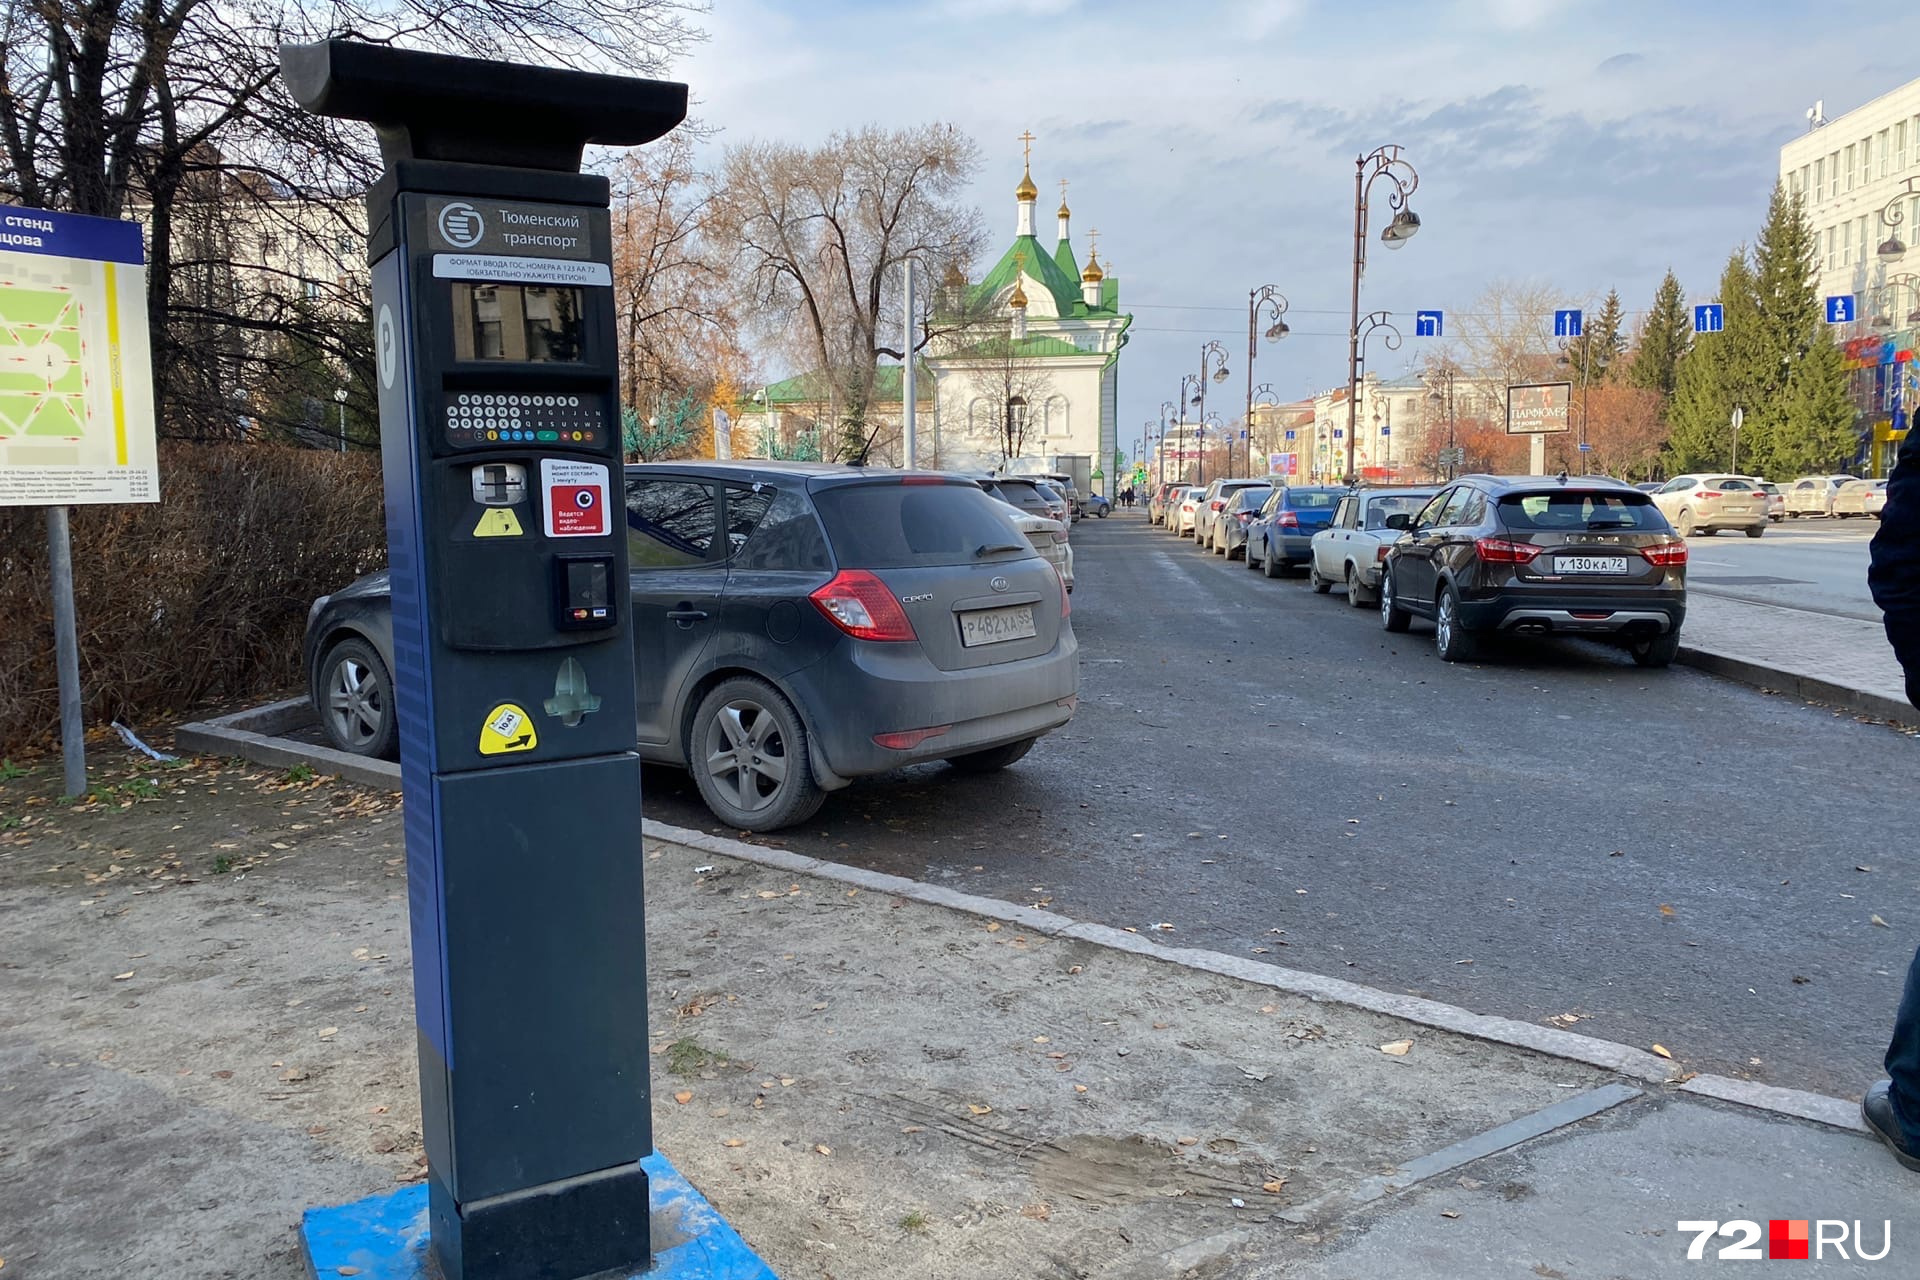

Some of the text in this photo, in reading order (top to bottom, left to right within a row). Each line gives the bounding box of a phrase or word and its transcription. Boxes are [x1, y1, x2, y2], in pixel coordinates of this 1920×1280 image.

[5, 215, 54, 233] стенд
[499, 209, 580, 229] Тюменский
[503, 233, 577, 250] транспорт
[449, 258, 482, 267] ФОРМАТ
[483, 260, 508, 269] ВВОДА
[509, 261, 525, 269] ГОС.
[526, 262, 555, 271] НОМЕРА
[587, 265, 596, 273] 72
[522, 271, 556, 280] УКАЖИТЕ
